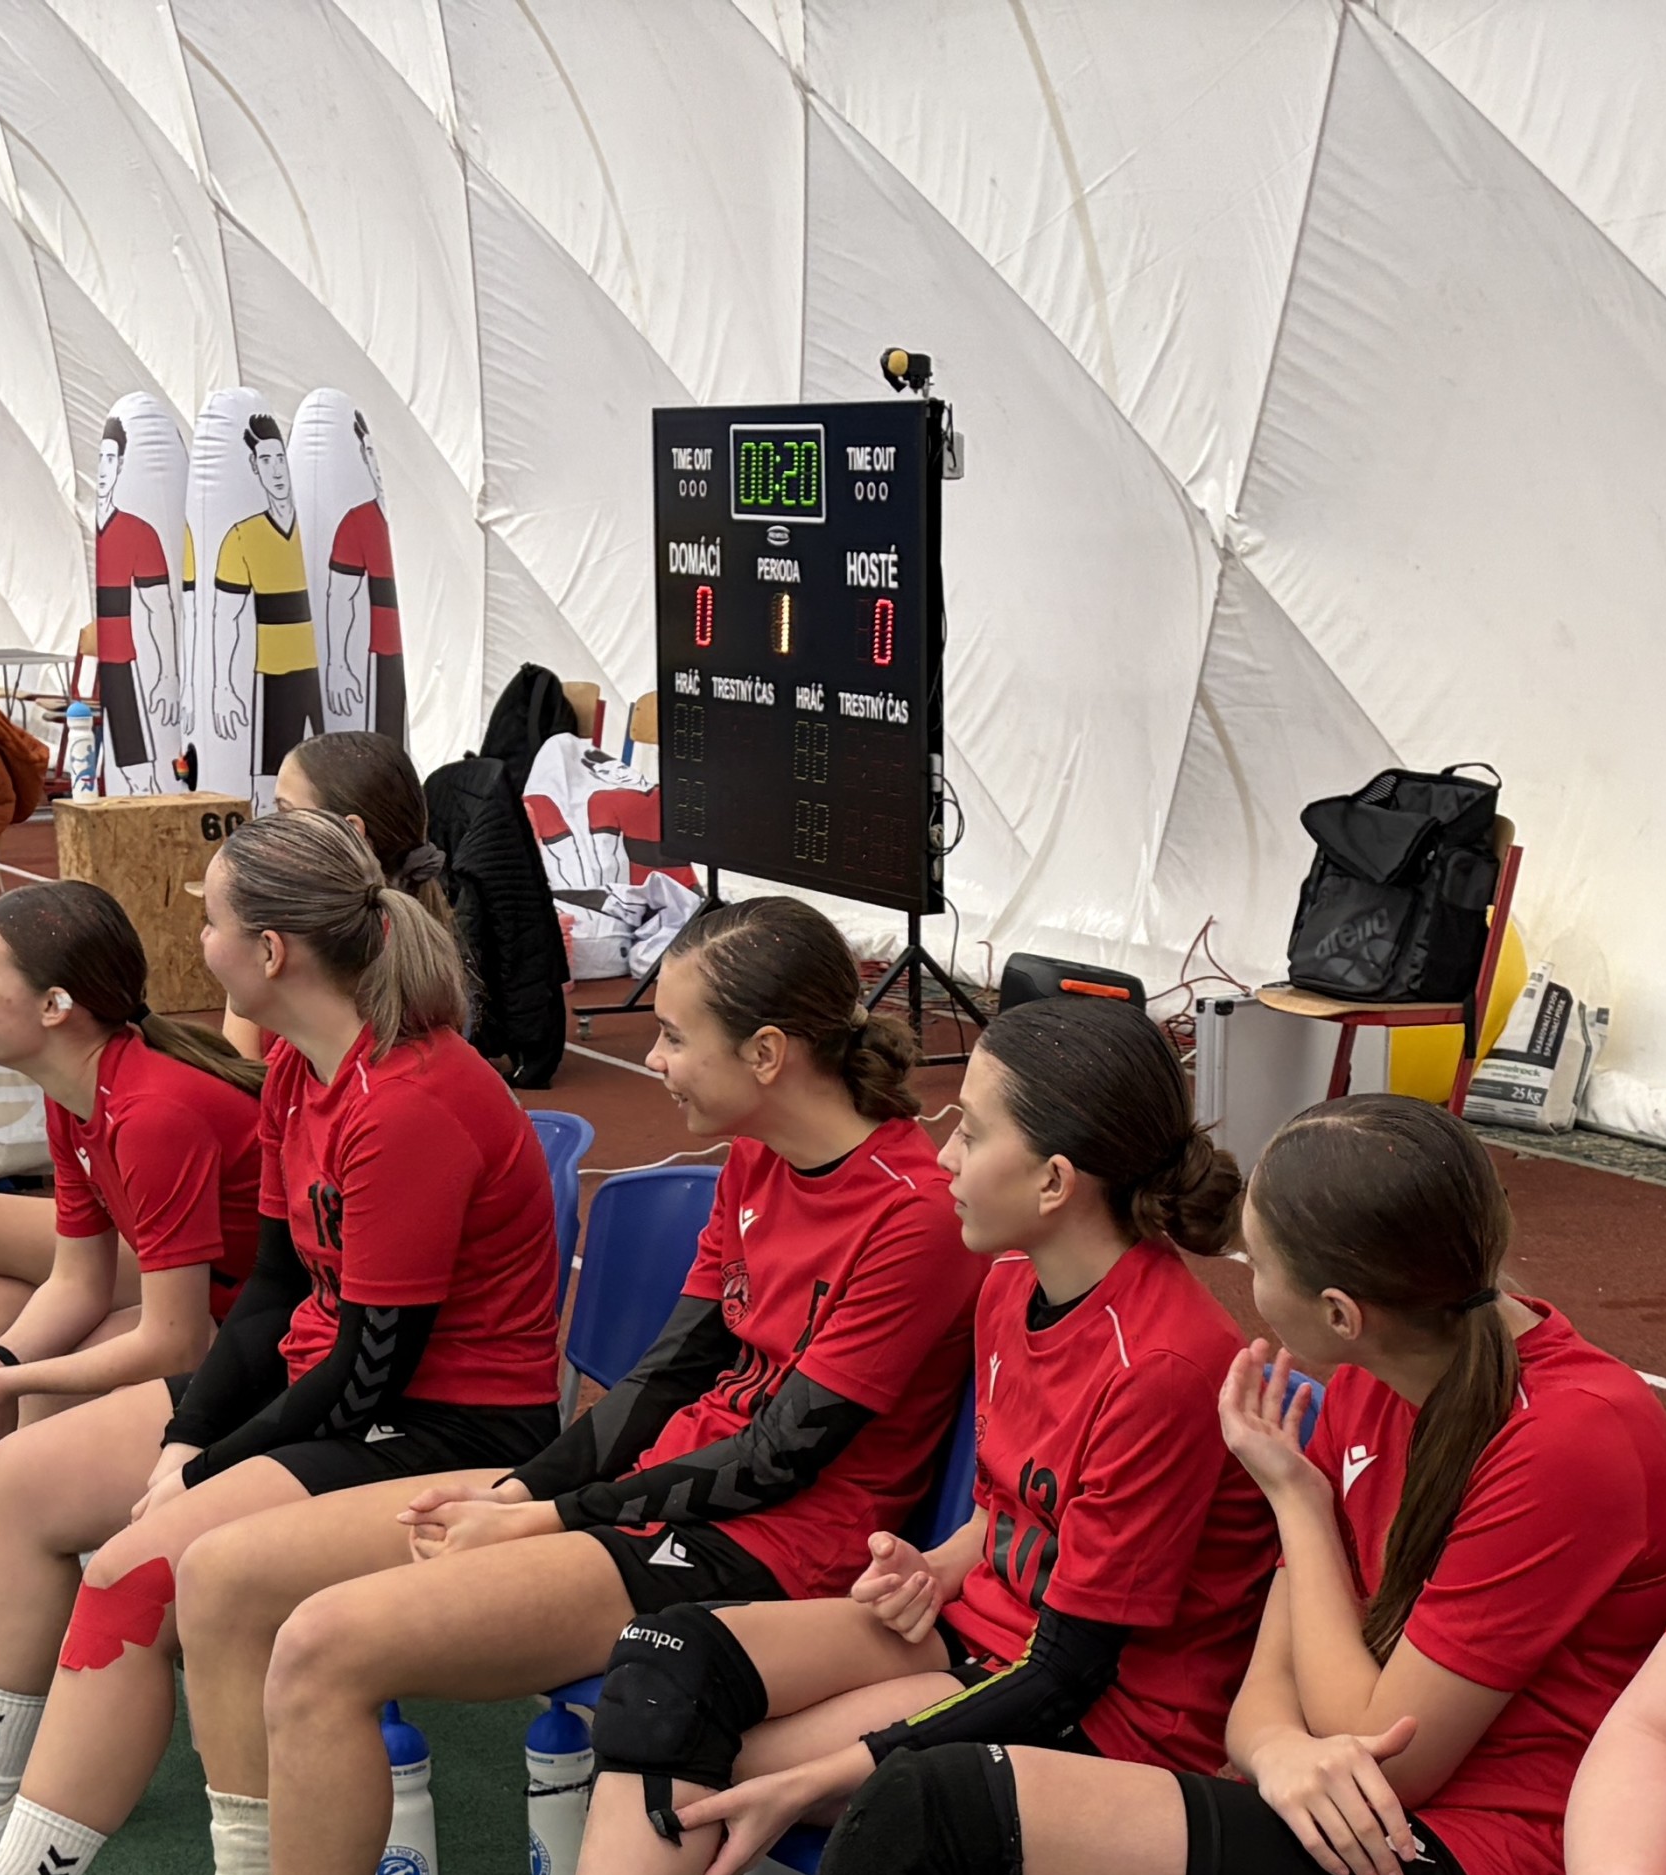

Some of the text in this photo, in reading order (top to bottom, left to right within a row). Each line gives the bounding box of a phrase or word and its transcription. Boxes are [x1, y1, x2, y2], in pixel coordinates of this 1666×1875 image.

[671, 448, 713, 470] TIME OUT
[846, 446, 897, 472] TIME OUT
[740, 442, 818, 506] 00:20
[669, 536, 721, 577] DOMÁCÍ
[757, 557, 801, 583] PERIODA
[846, 545, 899, 589] HOSTÉ
[695, 585, 713, 646] 0
[873, 599, 894, 665] 0
[675, 669, 701, 696] HRÁČ
[712, 676, 775, 706] TRESTNÝ ČAS
[796, 683, 825, 712] HRÁČ
[838, 692, 909, 724] TRESTNÝ ČAS
[1511, 1086, 1525, 1099] 25
[1526, 1088, 1543, 1105] kg
[619, 1623, 685, 1651] Kempa
